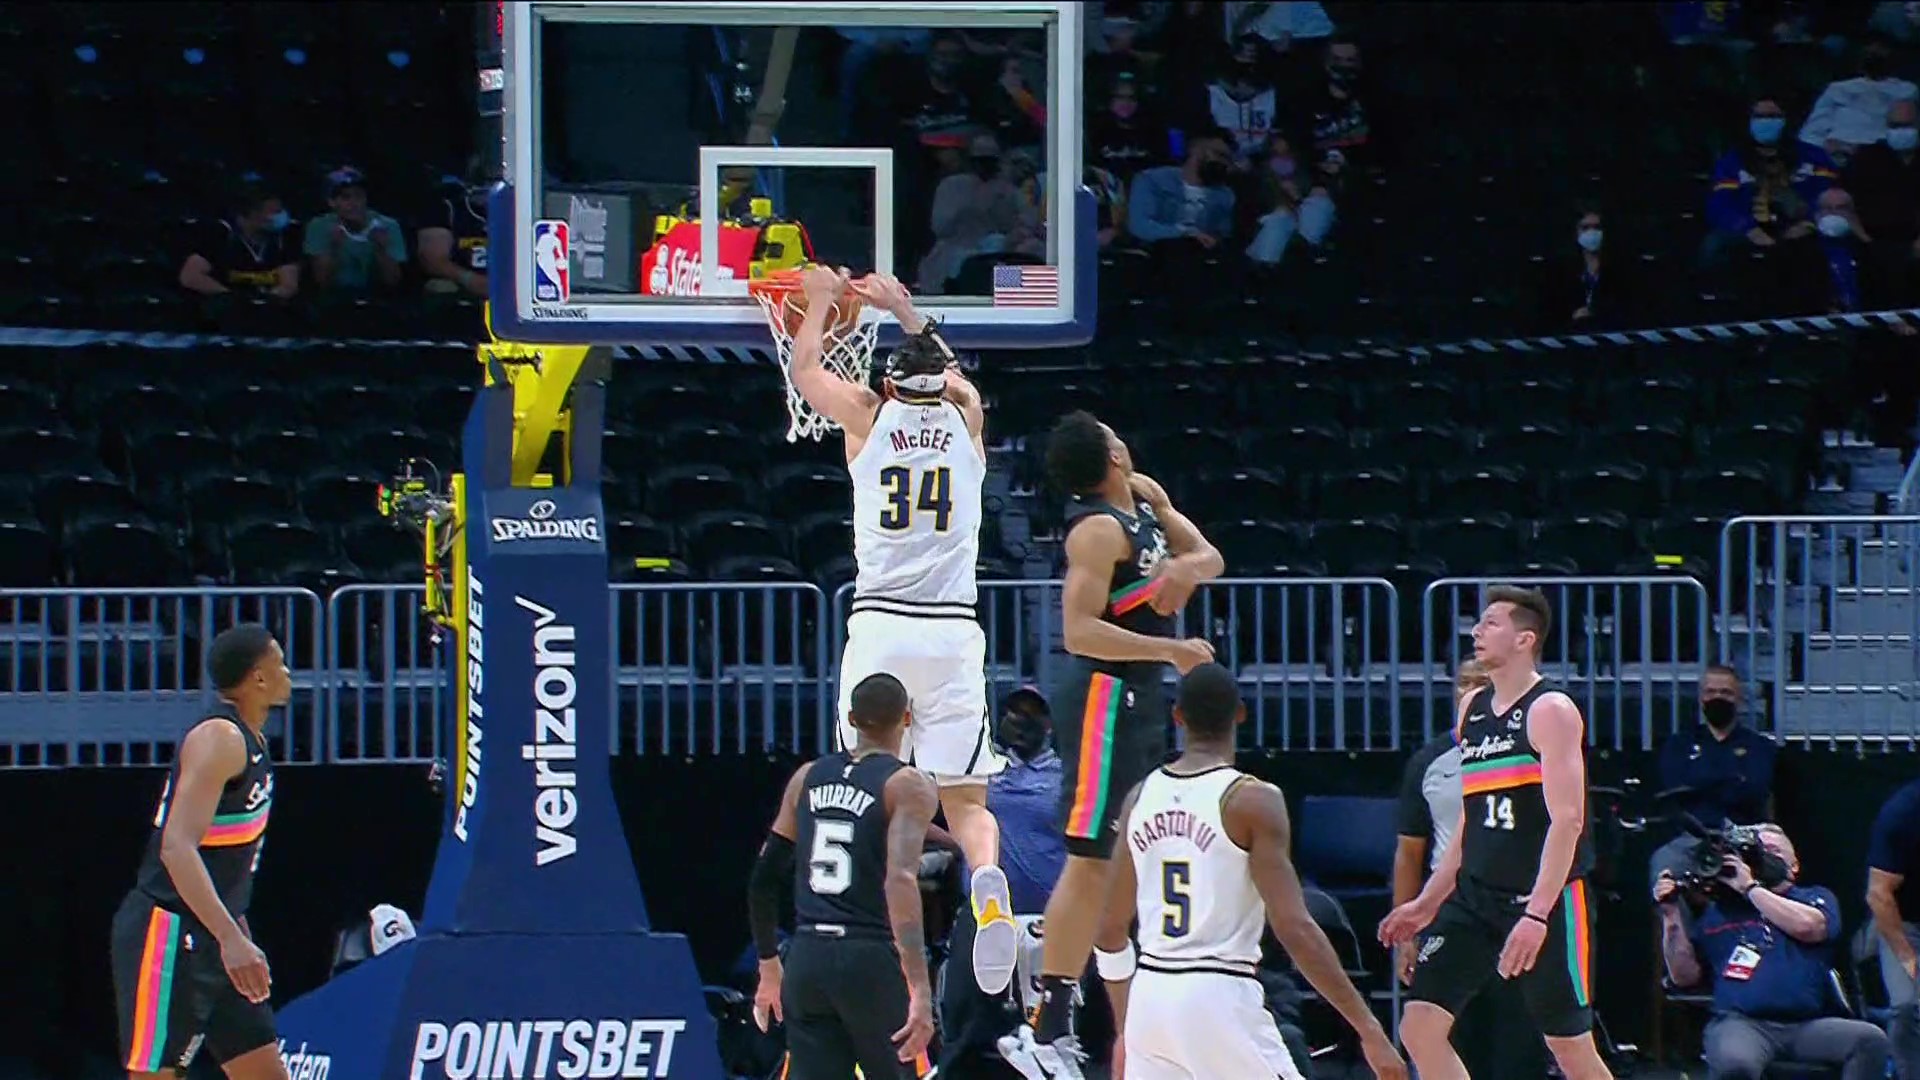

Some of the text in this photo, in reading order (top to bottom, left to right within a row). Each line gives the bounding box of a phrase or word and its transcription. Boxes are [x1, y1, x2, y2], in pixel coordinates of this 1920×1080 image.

[890, 428, 953, 452] McGEE
[491, 518, 602, 542] SPALDING
[879, 464, 953, 533] 34
[454, 565, 483, 842] POINTSBET
[521, 625, 578, 867] verizon
[808, 783, 876, 817] MURRAY
[1483, 794, 1516, 830] 14
[808, 819, 855, 895] 5
[1161, 861, 1191, 938] 5
[410, 1018, 687, 1080] POINTSBET
